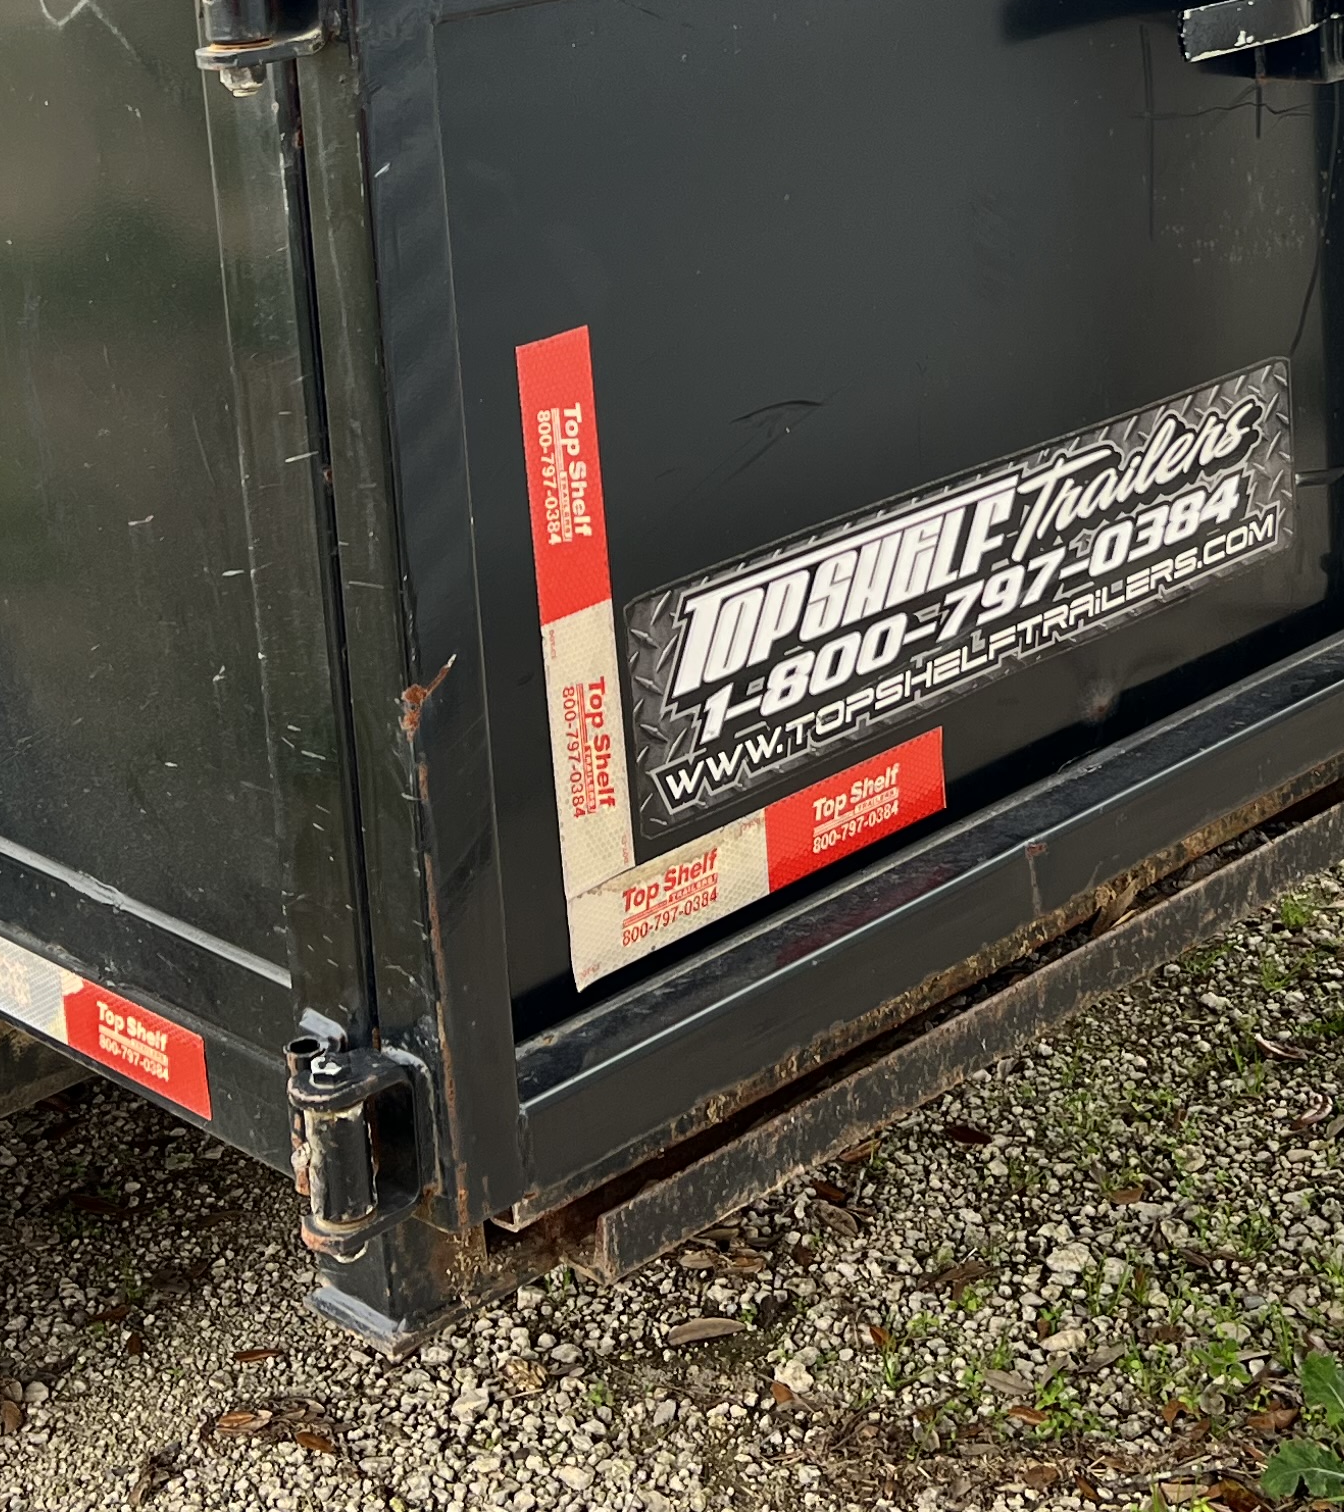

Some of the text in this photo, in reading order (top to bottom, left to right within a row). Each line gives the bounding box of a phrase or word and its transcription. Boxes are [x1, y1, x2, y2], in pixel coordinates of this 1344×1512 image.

[537, 409, 562, 545] 800-797-0384
[560, 402, 593, 536] Top Shelf
[1011, 402, 1254, 562] Trailers
[699, 473, 1241, 745] 1-800-797-0384
[562, 686, 586, 818] 800-797-0384
[585, 676, 616, 808] Top Shelf
[812, 799, 899, 854] 800-797-0384
[813, 762, 900, 821] Top Shelf
[622, 880, 660, 913] Top
[664, 848, 719, 892] Shelf
[622, 887, 719, 948] 800-797-0384
[97, 1000, 168, 1052] Top Shelf
[98, 1033, 169, 1083] 800-797-0384
